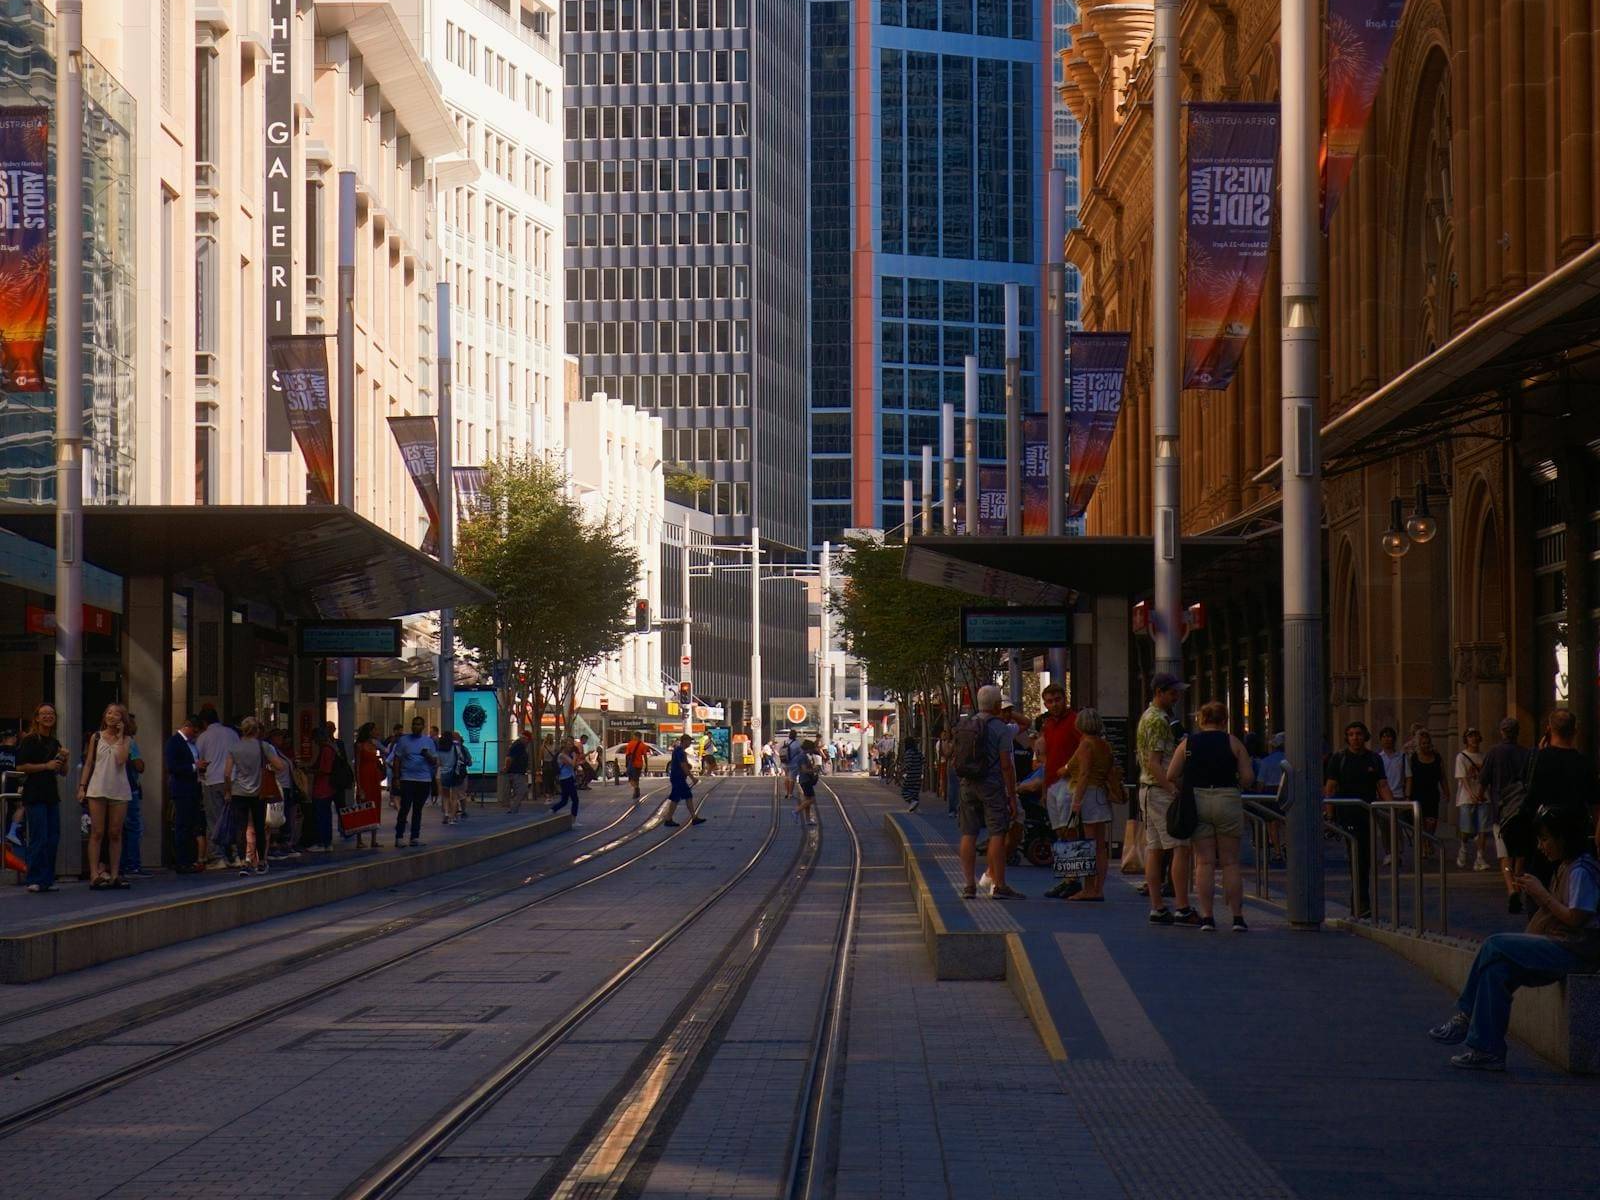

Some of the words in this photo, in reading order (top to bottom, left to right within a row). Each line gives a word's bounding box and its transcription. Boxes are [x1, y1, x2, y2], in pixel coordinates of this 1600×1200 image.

[0, 120, 43, 129] USTRALIA
[22, 170, 46, 230] STORY
[266, 121, 289, 392] GALERIS
[792, 707, 801, 720] T
